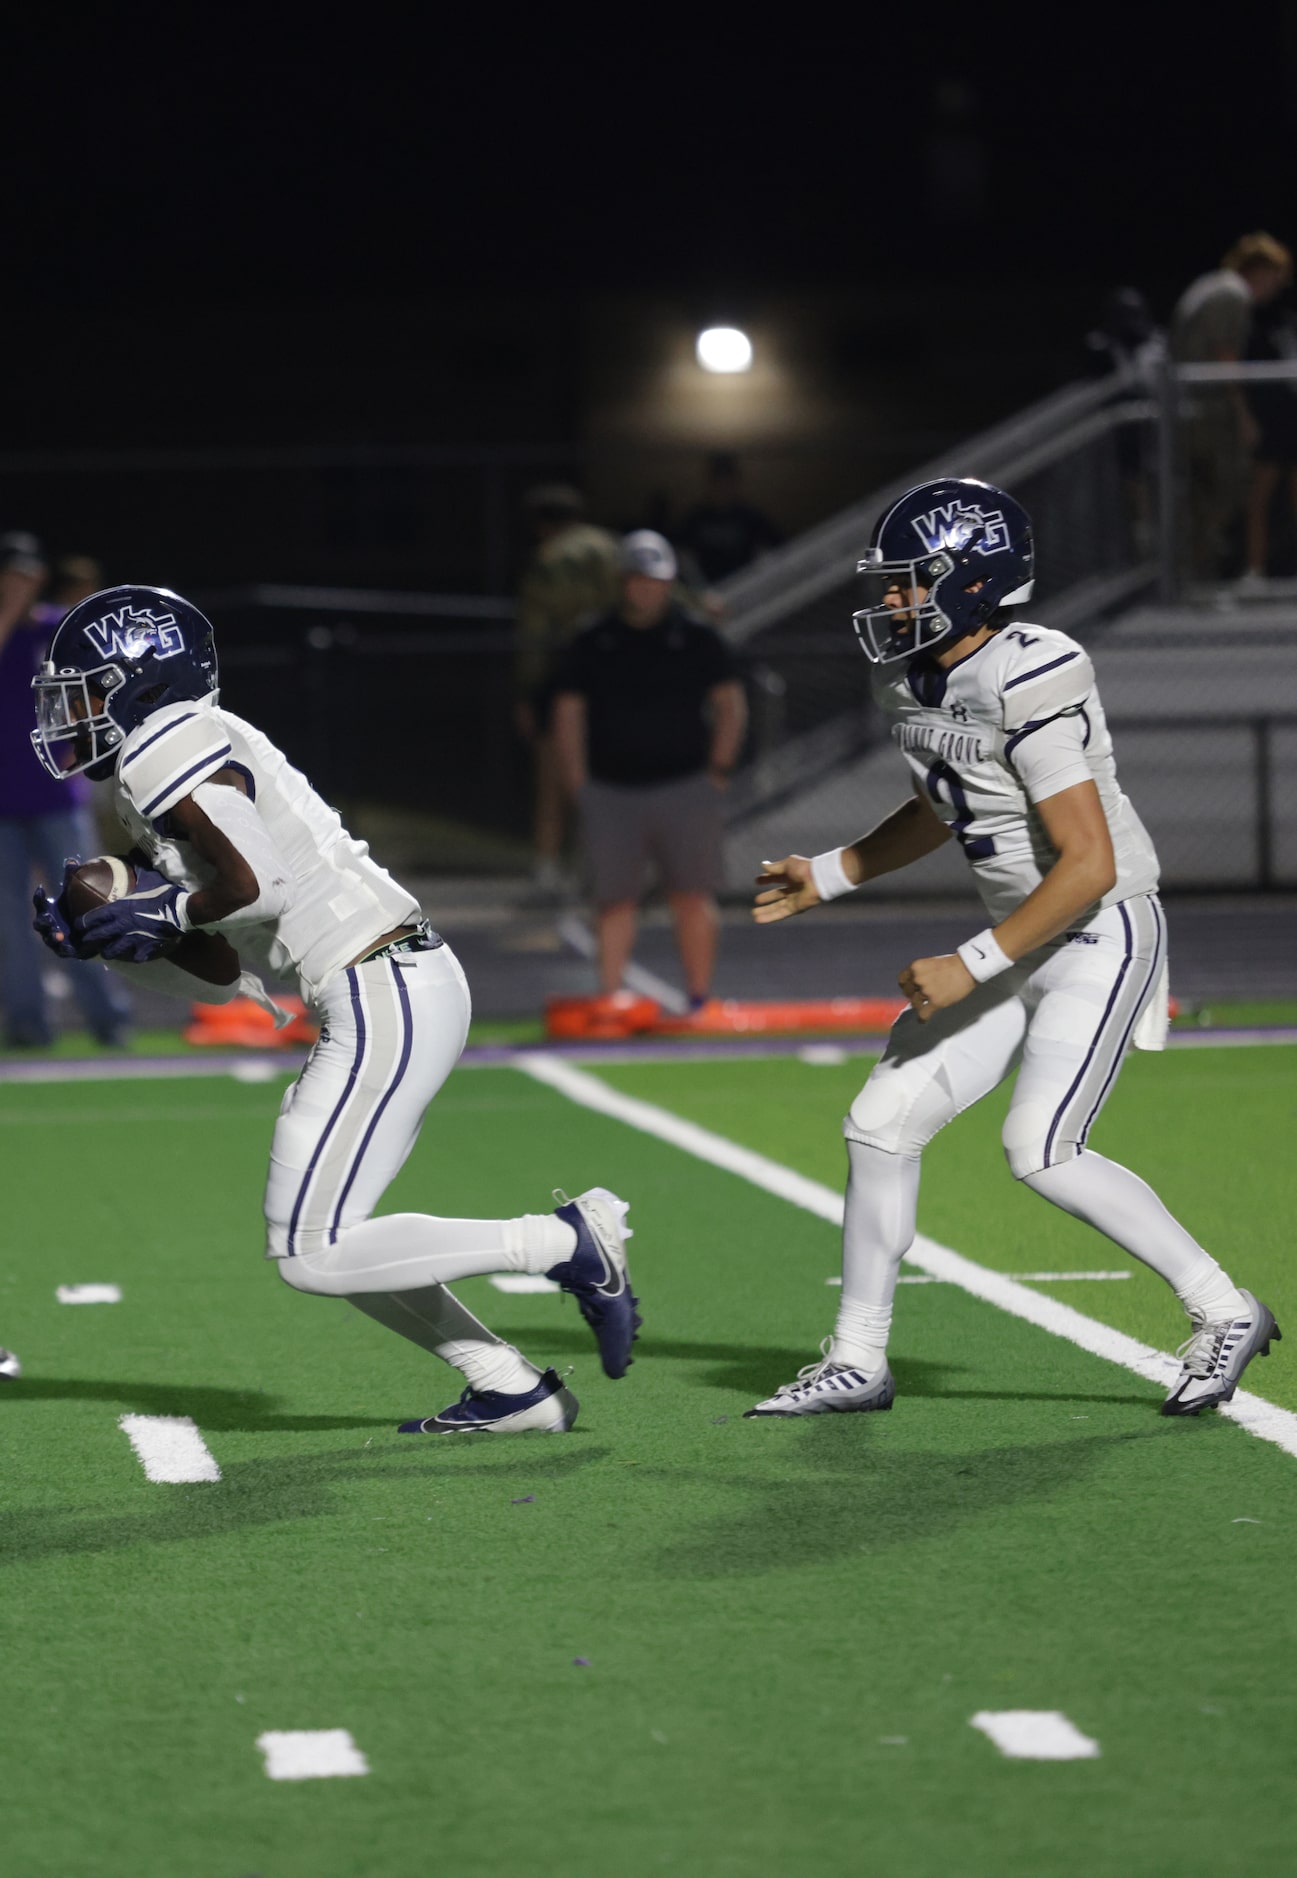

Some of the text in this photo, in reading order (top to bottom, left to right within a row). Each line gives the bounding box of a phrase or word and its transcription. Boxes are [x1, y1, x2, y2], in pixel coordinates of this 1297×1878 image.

[1005, 630, 1041, 648] 2
[938, 731, 985, 764] GROVE
[926, 758, 998, 862] 2
